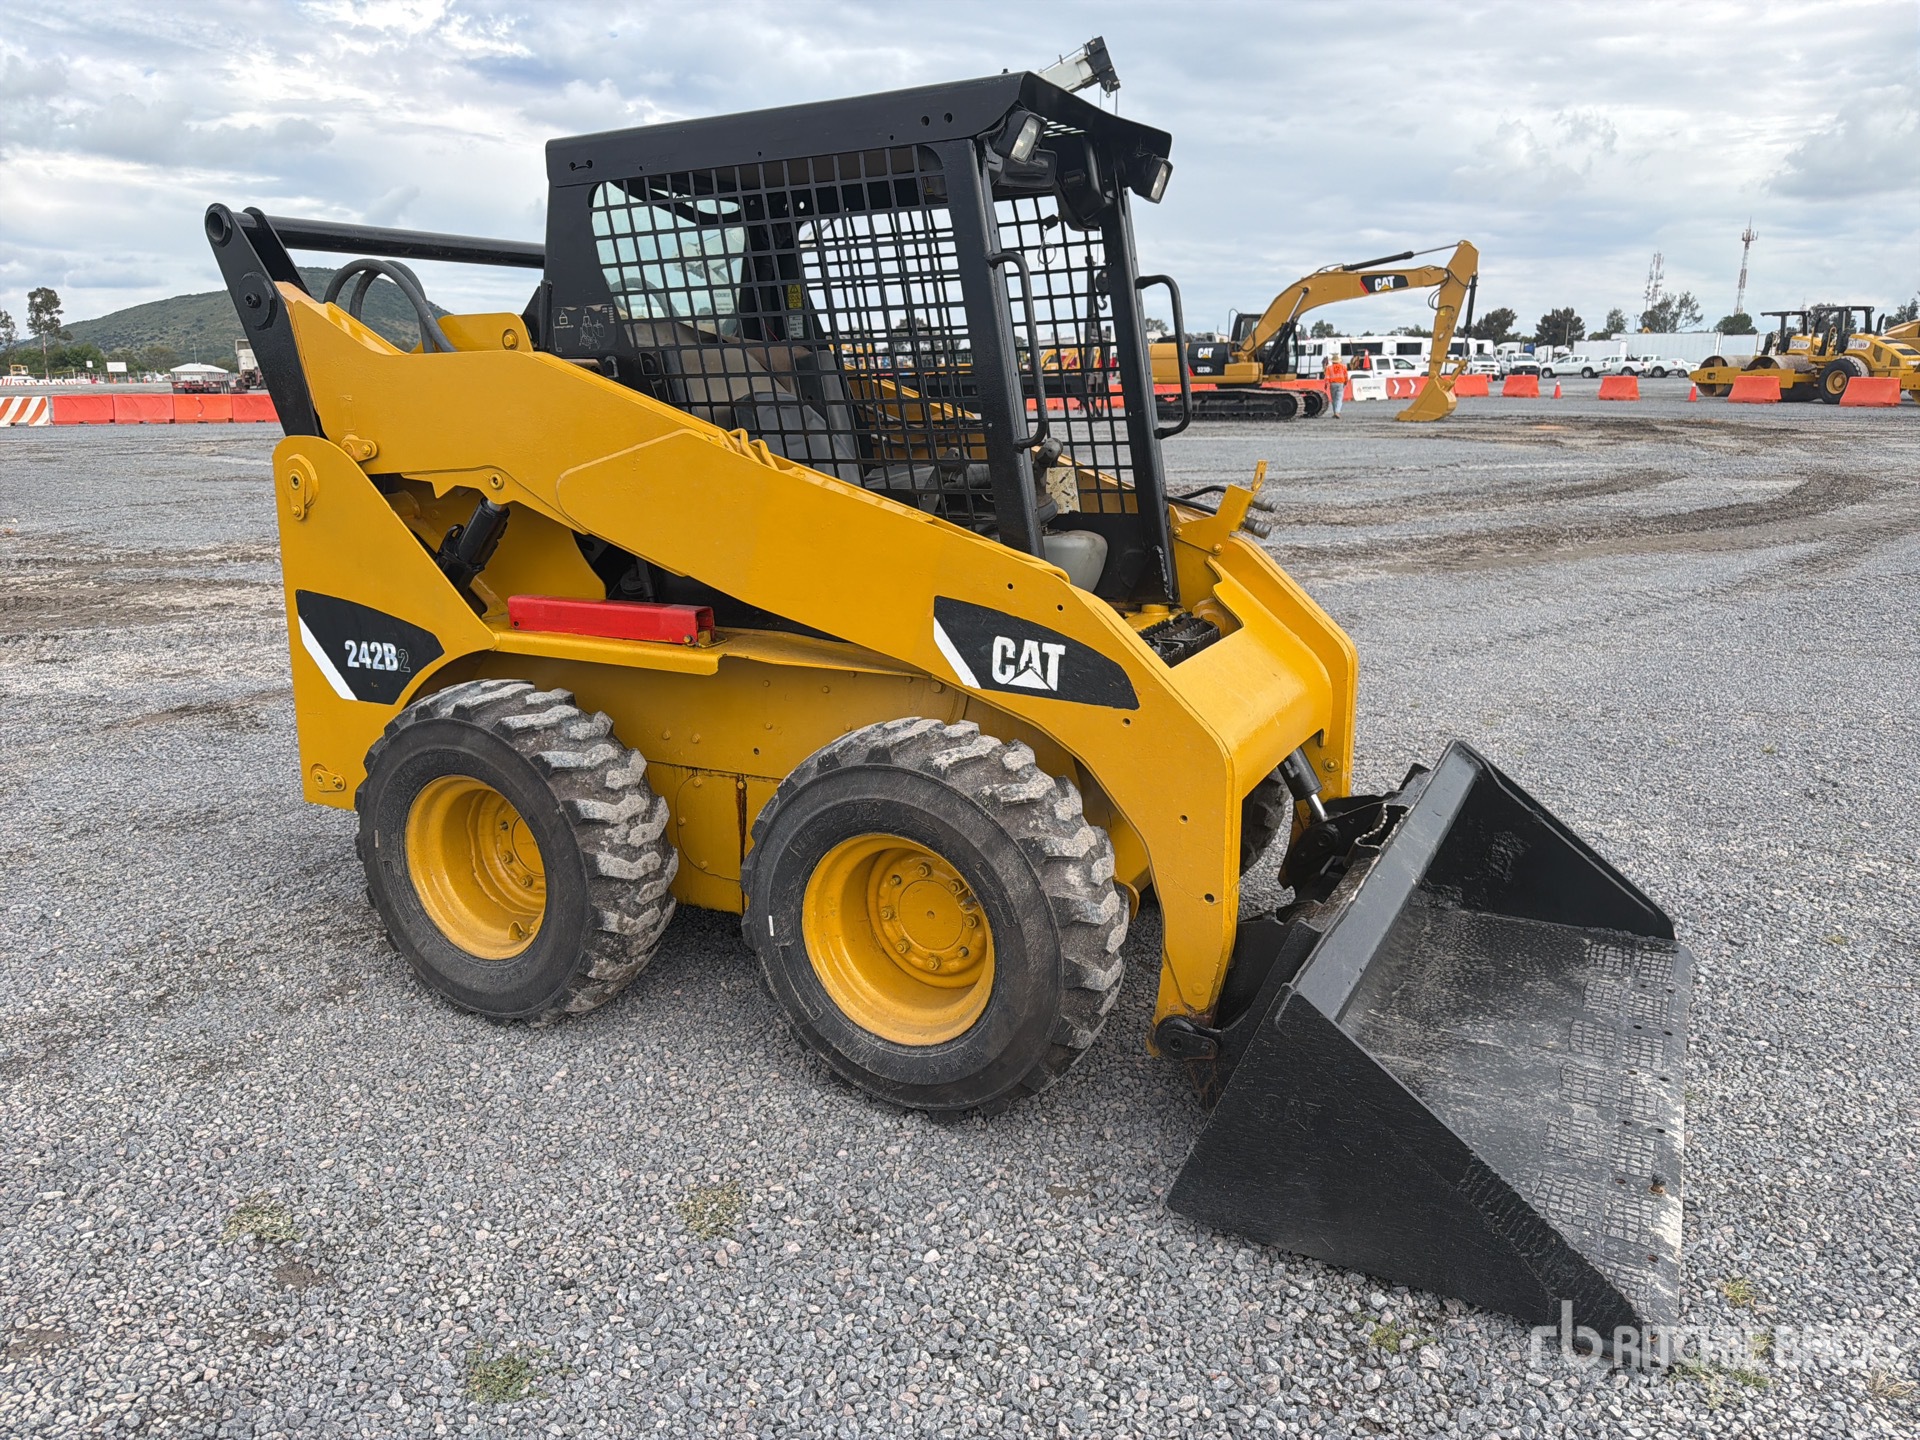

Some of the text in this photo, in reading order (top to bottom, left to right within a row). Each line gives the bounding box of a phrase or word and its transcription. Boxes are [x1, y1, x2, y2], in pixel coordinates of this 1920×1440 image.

[1374, 275, 1396, 292] CAT
[1197, 347, 1214, 359] CAT
[344, 639, 411, 673] 242B2
[991, 635, 1066, 691] CAT
